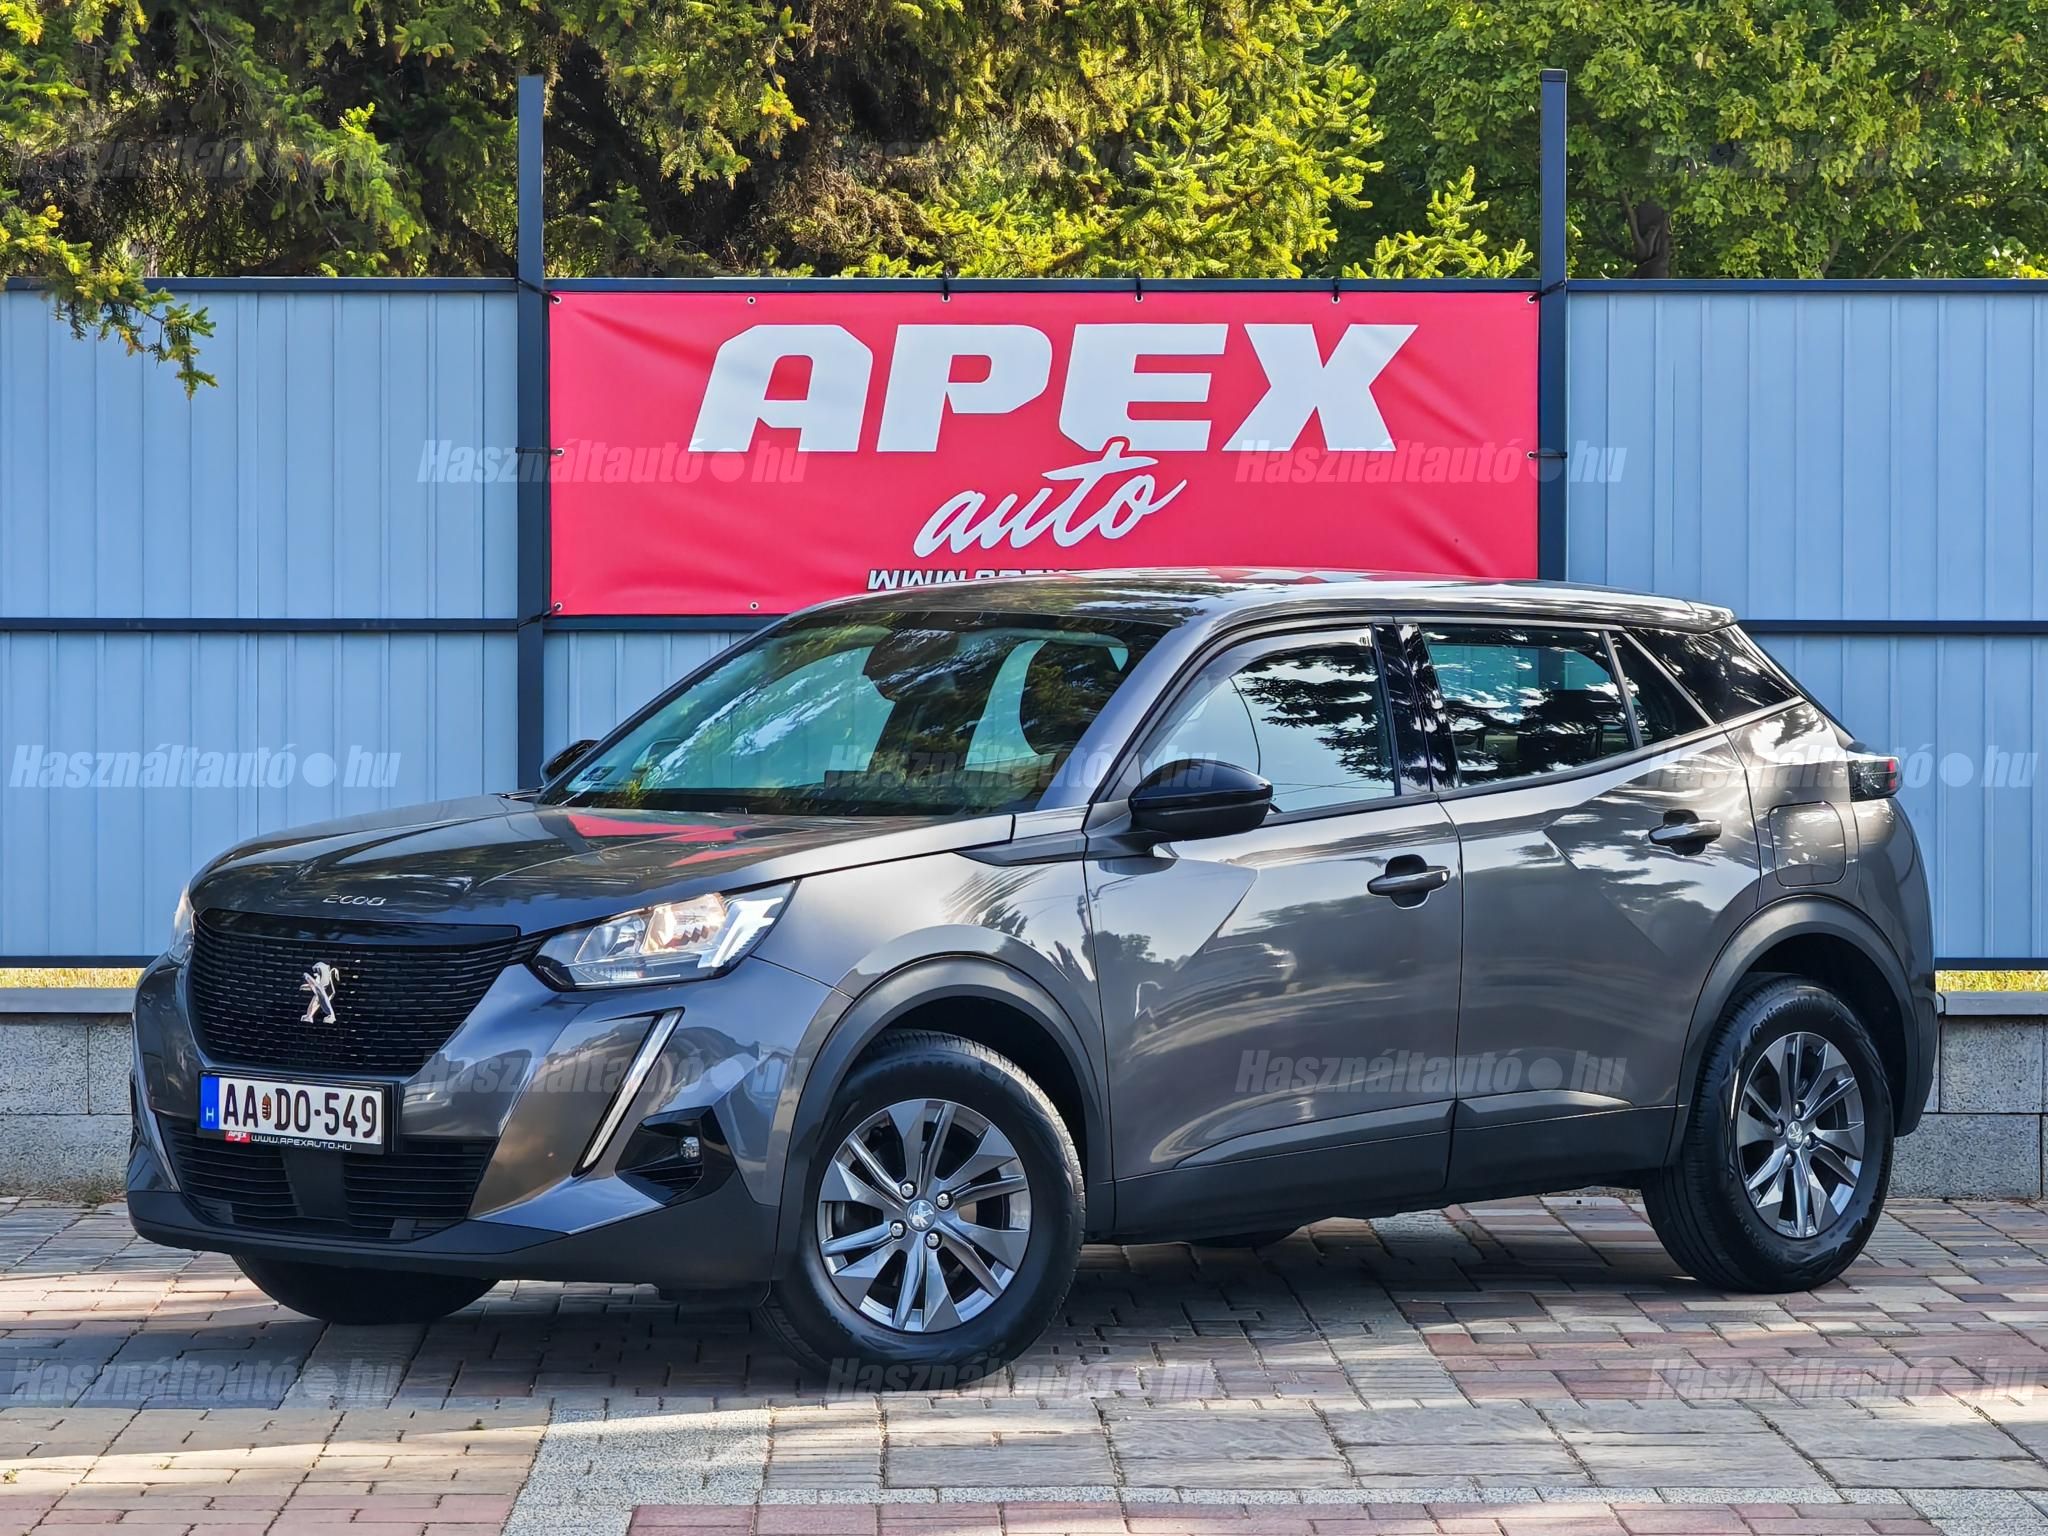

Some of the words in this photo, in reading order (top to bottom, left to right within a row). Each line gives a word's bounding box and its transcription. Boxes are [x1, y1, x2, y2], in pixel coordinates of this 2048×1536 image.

[687, 322, 1419, 453] APEX
[912, 439, 1188, 558] auto
[205, 1107, 215, 1122] H
[251, 1135, 352, 1150] WWW.APEXAUTO.HU
